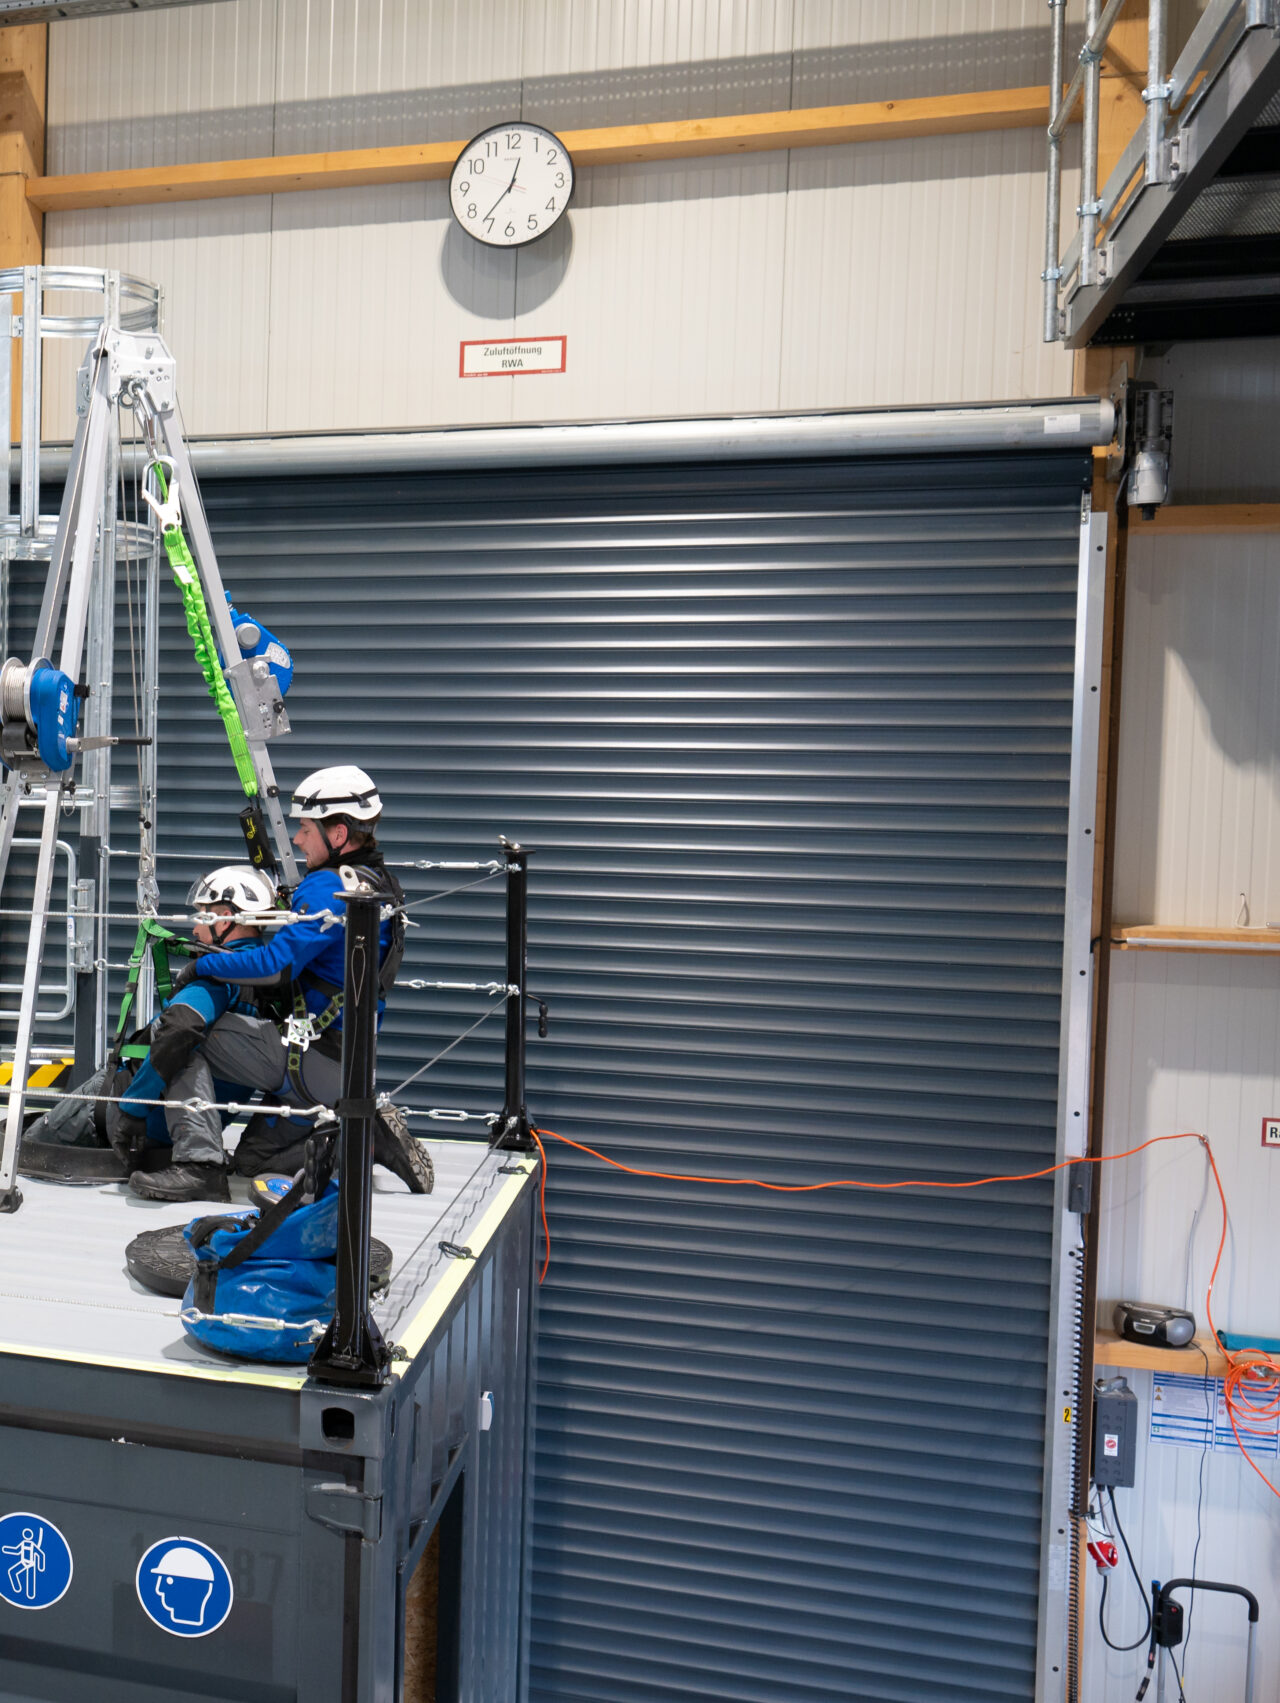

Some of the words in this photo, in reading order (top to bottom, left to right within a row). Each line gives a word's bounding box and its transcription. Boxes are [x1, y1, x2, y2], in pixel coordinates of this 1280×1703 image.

[505, 133, 522, 150] 12
[485, 142, 499, 158] 11
[546, 149, 557, 166] 2
[467, 158, 485, 175] 10
[555, 172, 565, 188] 3
[459, 181, 470, 197] 9
[467, 203, 478, 218] 8
[545, 197, 556, 212] 4
[486, 217, 495, 234] 7
[504, 221, 515, 237] 6
[527, 214, 538, 230] 5
[483, 345, 542, 357] Zuluftöffnung
[501, 359, 524, 368] RWA
[1064, 1407, 1070, 1423] 2
